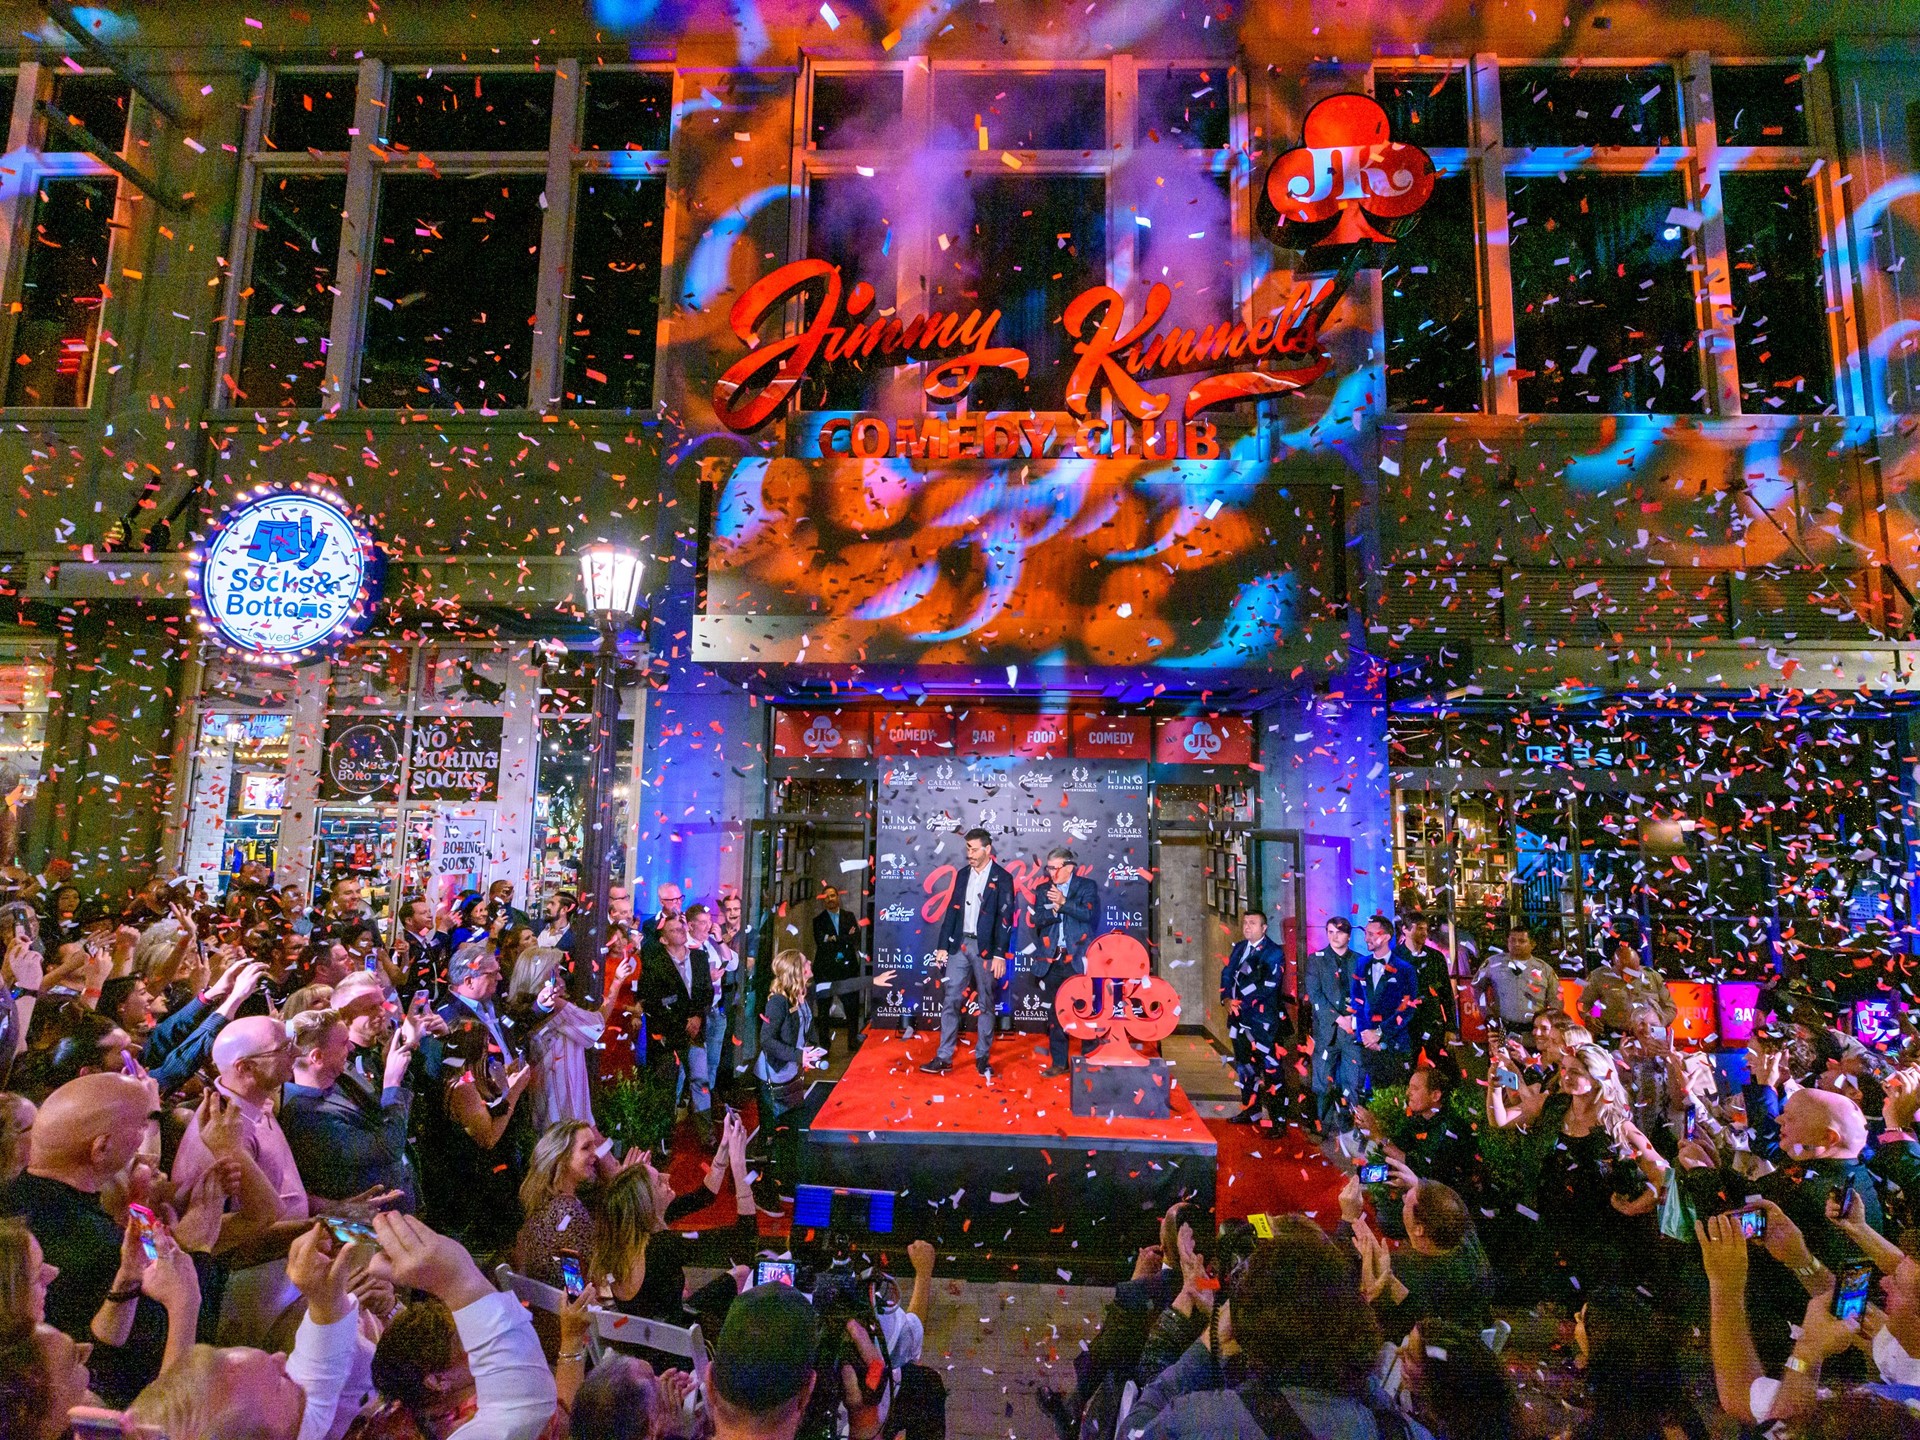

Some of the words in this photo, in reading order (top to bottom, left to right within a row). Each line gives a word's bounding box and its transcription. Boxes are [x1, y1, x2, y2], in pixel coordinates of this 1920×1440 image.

[711, 258, 1030, 434] Jimmy
[1064, 279, 1336, 424] Kimmel's
[819, 418, 1057, 460] COMEDY
[1075, 418, 1220, 460] CLUB
[417, 731, 448, 748] NO
[889, 729, 934, 742] COMEDY
[973, 730, 996, 743] BAR
[1027, 731, 1056, 744] FOOD
[1089, 732, 1135, 745] COMEDY
[339, 758, 388, 769] Soks&
[414, 751, 499, 769] BORING
[412, 770, 487, 788] SOCKS
[973, 774, 1007, 782] LINQ
[1108, 775, 1143, 784] LINQ
[1016, 818, 1051, 827] LINQ
[443, 841, 481, 854] BORING
[878, 954, 913, 963] LINQ
[923, 1002, 943, 1011] LIN
[1678, 1006, 1708, 1020] MEDY
